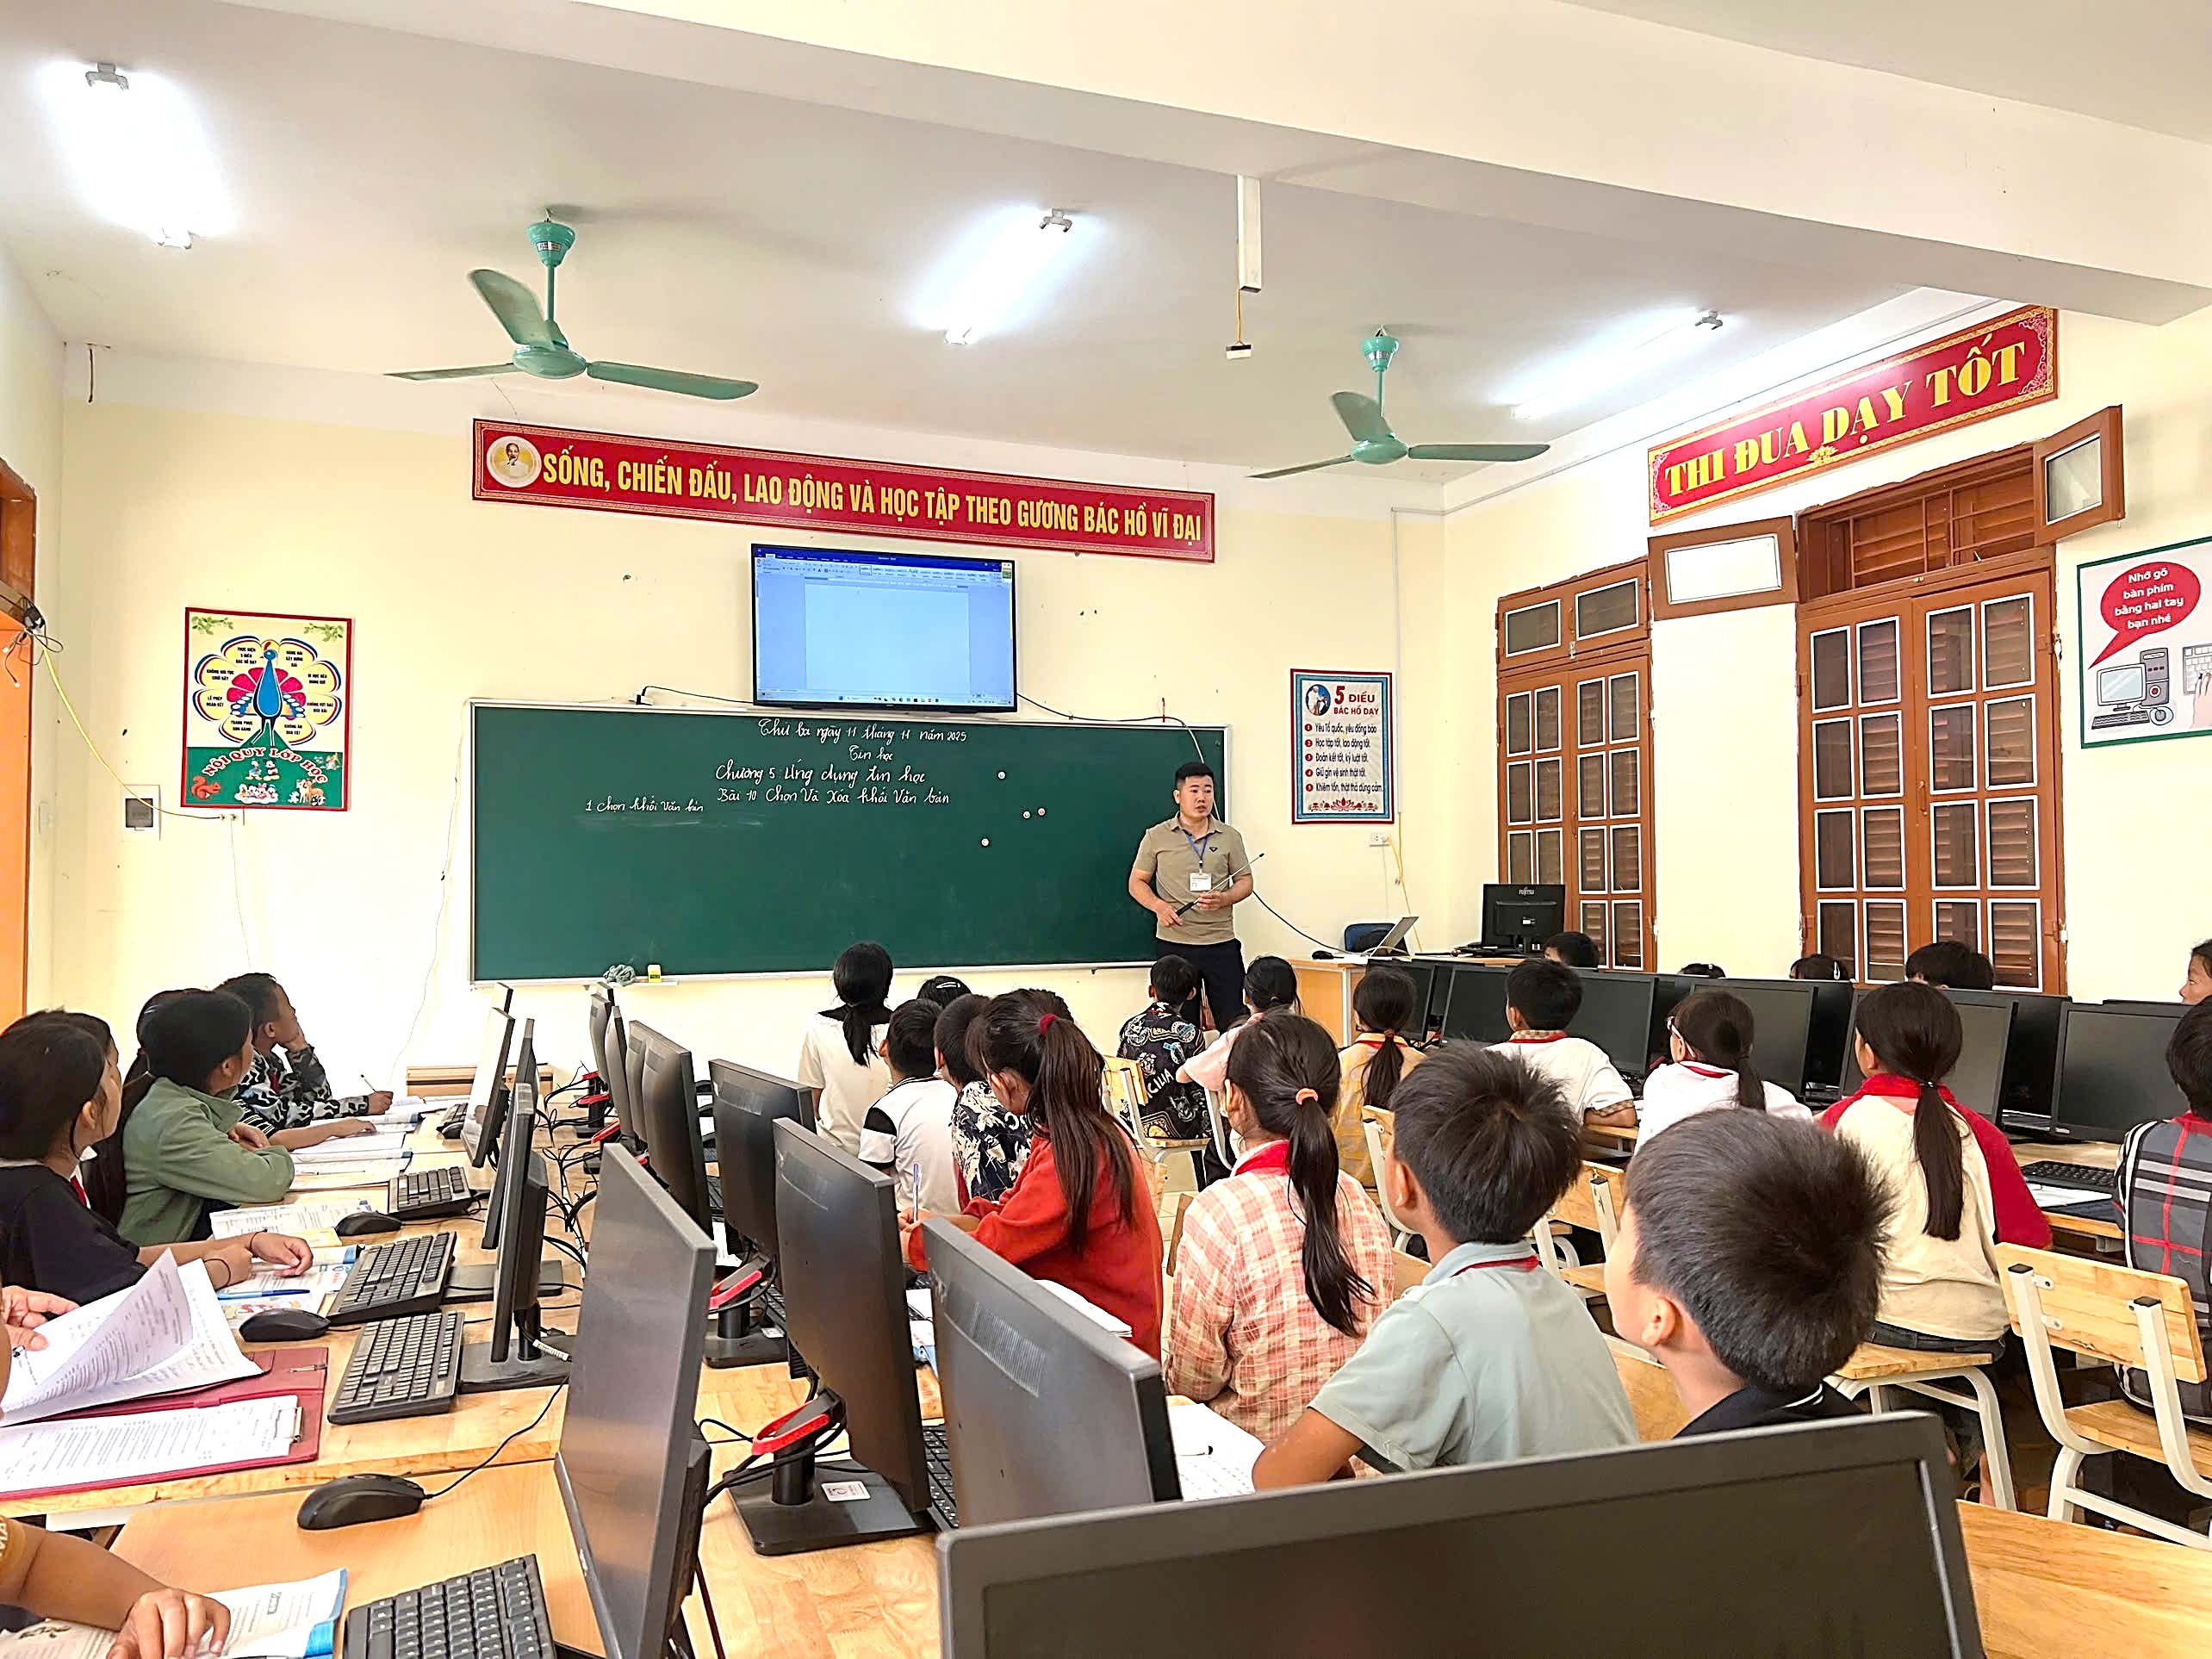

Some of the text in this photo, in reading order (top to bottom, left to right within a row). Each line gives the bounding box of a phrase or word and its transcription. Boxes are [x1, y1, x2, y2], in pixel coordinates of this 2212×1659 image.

[1665, 333, 2025, 497] THI ĐUA DẠY TỐT
[543, 444, 1201, 545] SỐNG, CHIẾN ĐẤU, LAO ĐỘNG VÀ HỌC TẬP THEO GƯƠNG BÁC HỒ VĨ ĐẠI
[2128, 570, 2152, 583] Nhớ
[2123, 583, 2174, 600] bàn phím
[2115, 596, 2184, 616] bằng hai tay
[2128, 613, 2172, 631] bạn nhé
[1334, 686, 1375, 705] 5 ĐIỀU
[1334, 705, 1379, 717] BÁC HỒ DẠY
[795, 721, 811, 737] ba
[817, 725, 841, 744] ngày
[846, 726, 857, 737] 11
[861, 724, 895, 746] tháng
[900, 729, 910, 740] 11
[947, 731, 967, 741] 2025
[849, 744, 893, 761] Tin học
[203, 747, 328, 783] NỘI QUY LỚP HỌC
[716, 759, 764, 785] Chương
[821, 763, 858, 789] dụng
[866, 765, 891, 782] tin
[898, 765, 926, 784] học
[717, 788, 740, 802] Bài
[746, 790, 757, 801] 10
[766, 784, 798, 803] Chọn
[924, 787, 949, 804] bản
[685, 798, 704, 812] bản
[1146, 1068, 1174, 1099] ICILIA
